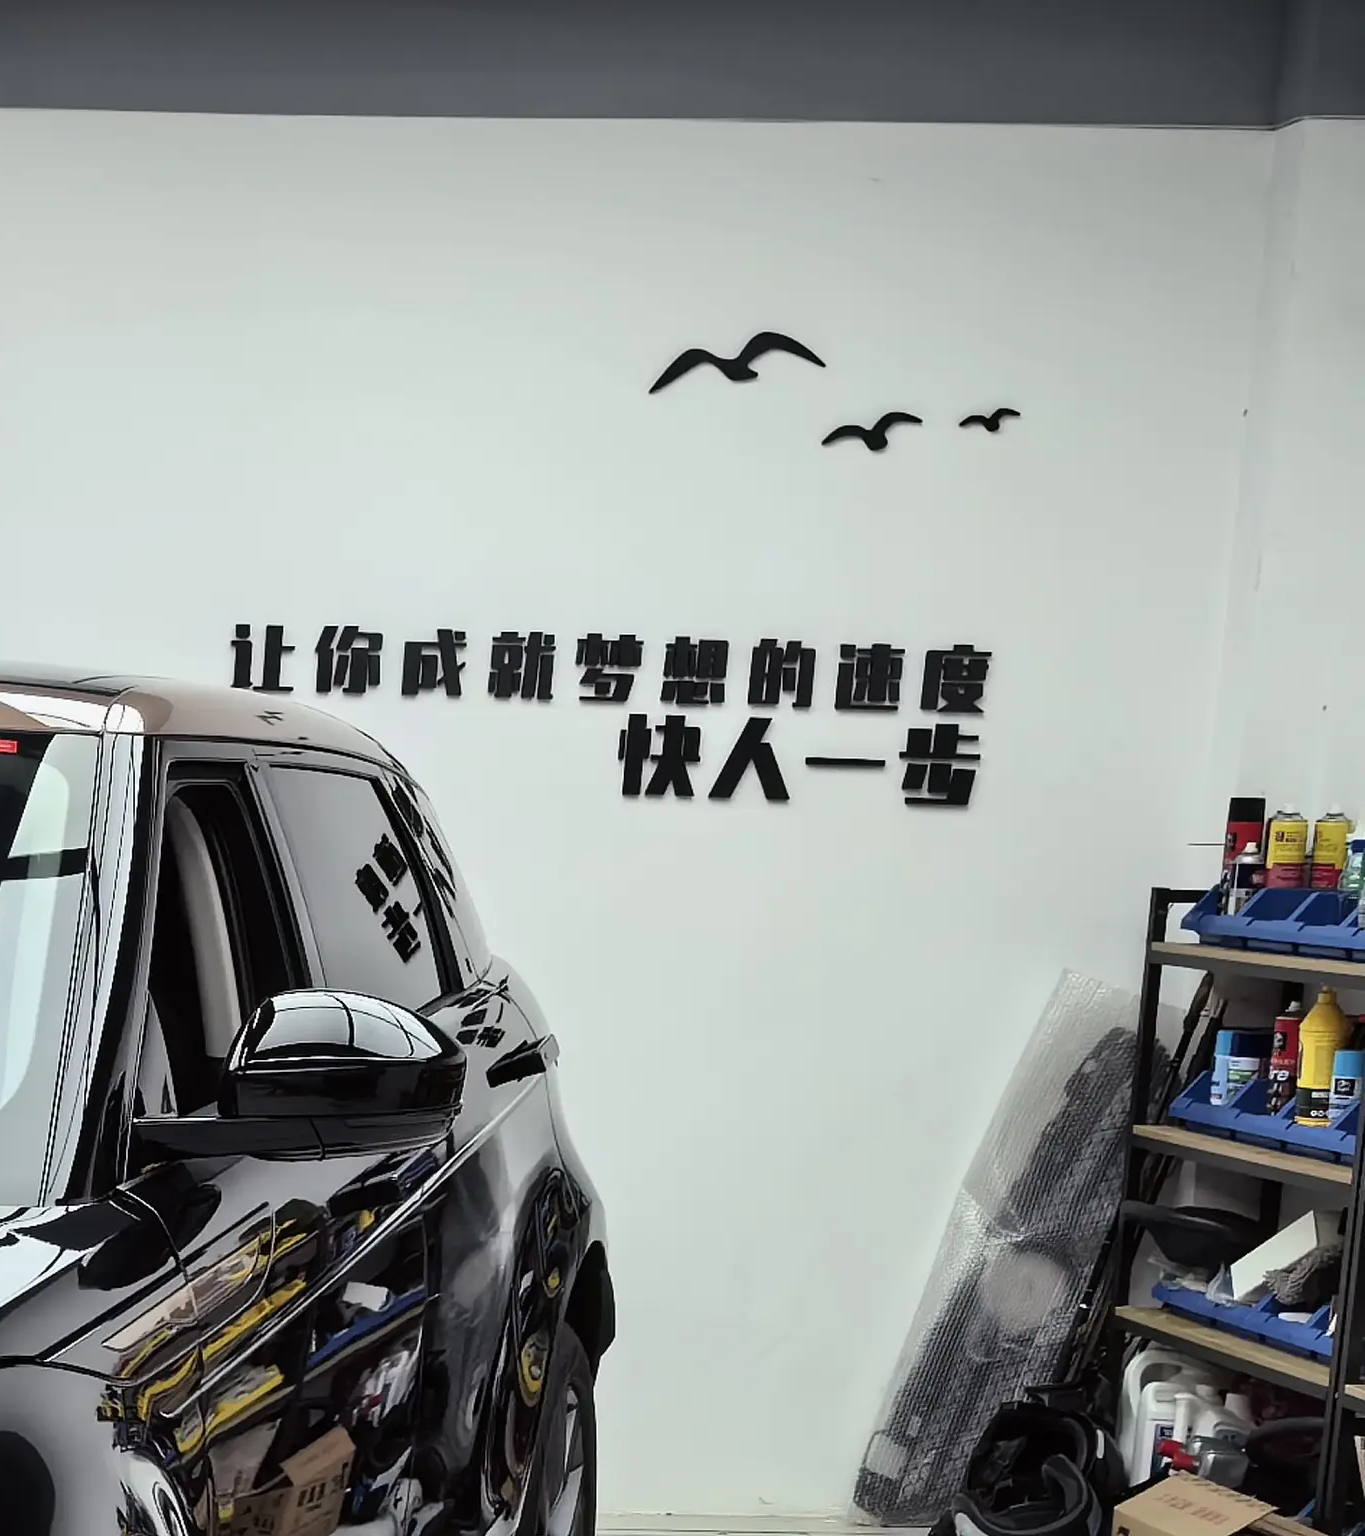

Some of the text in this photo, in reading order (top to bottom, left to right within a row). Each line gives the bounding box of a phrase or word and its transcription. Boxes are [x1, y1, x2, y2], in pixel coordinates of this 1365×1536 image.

[230, 623, 993, 714] 让你成就梦想的速度
[618, 712, 984, 808] 快人一步
